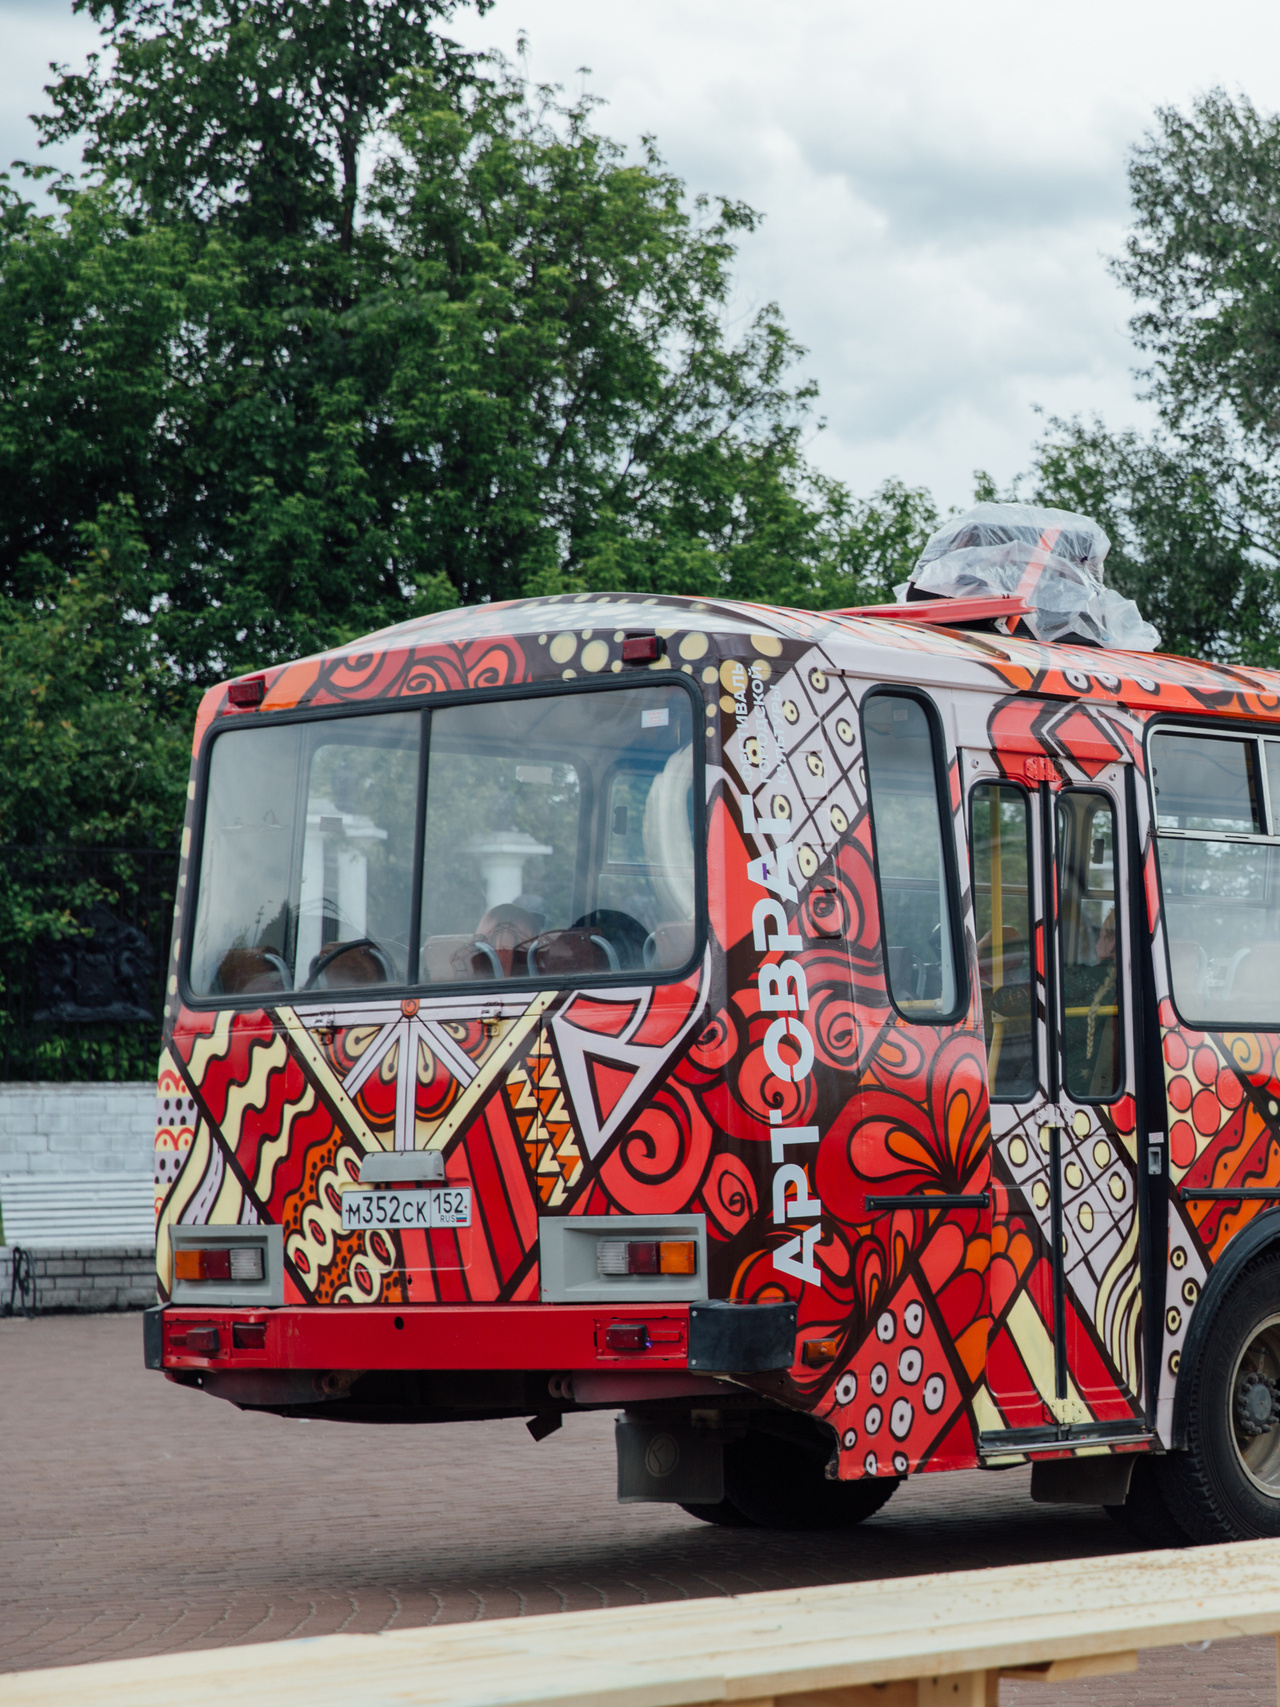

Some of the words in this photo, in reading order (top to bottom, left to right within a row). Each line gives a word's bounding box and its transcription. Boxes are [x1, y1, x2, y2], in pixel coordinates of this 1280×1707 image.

[732, 662, 753, 782] ФЕСТИВАЛЬ
[748, 665, 772, 784] ГОРОДСКОЙ
[769, 685, 788, 785] КУЛЬТУРЫ
[740, 793, 815, 1083] ОВРАГ
[433, 1192, 464, 1214] 152
[440, 1214, 456, 1223] RUS
[769, 1109, 822, 1288] АРТ
